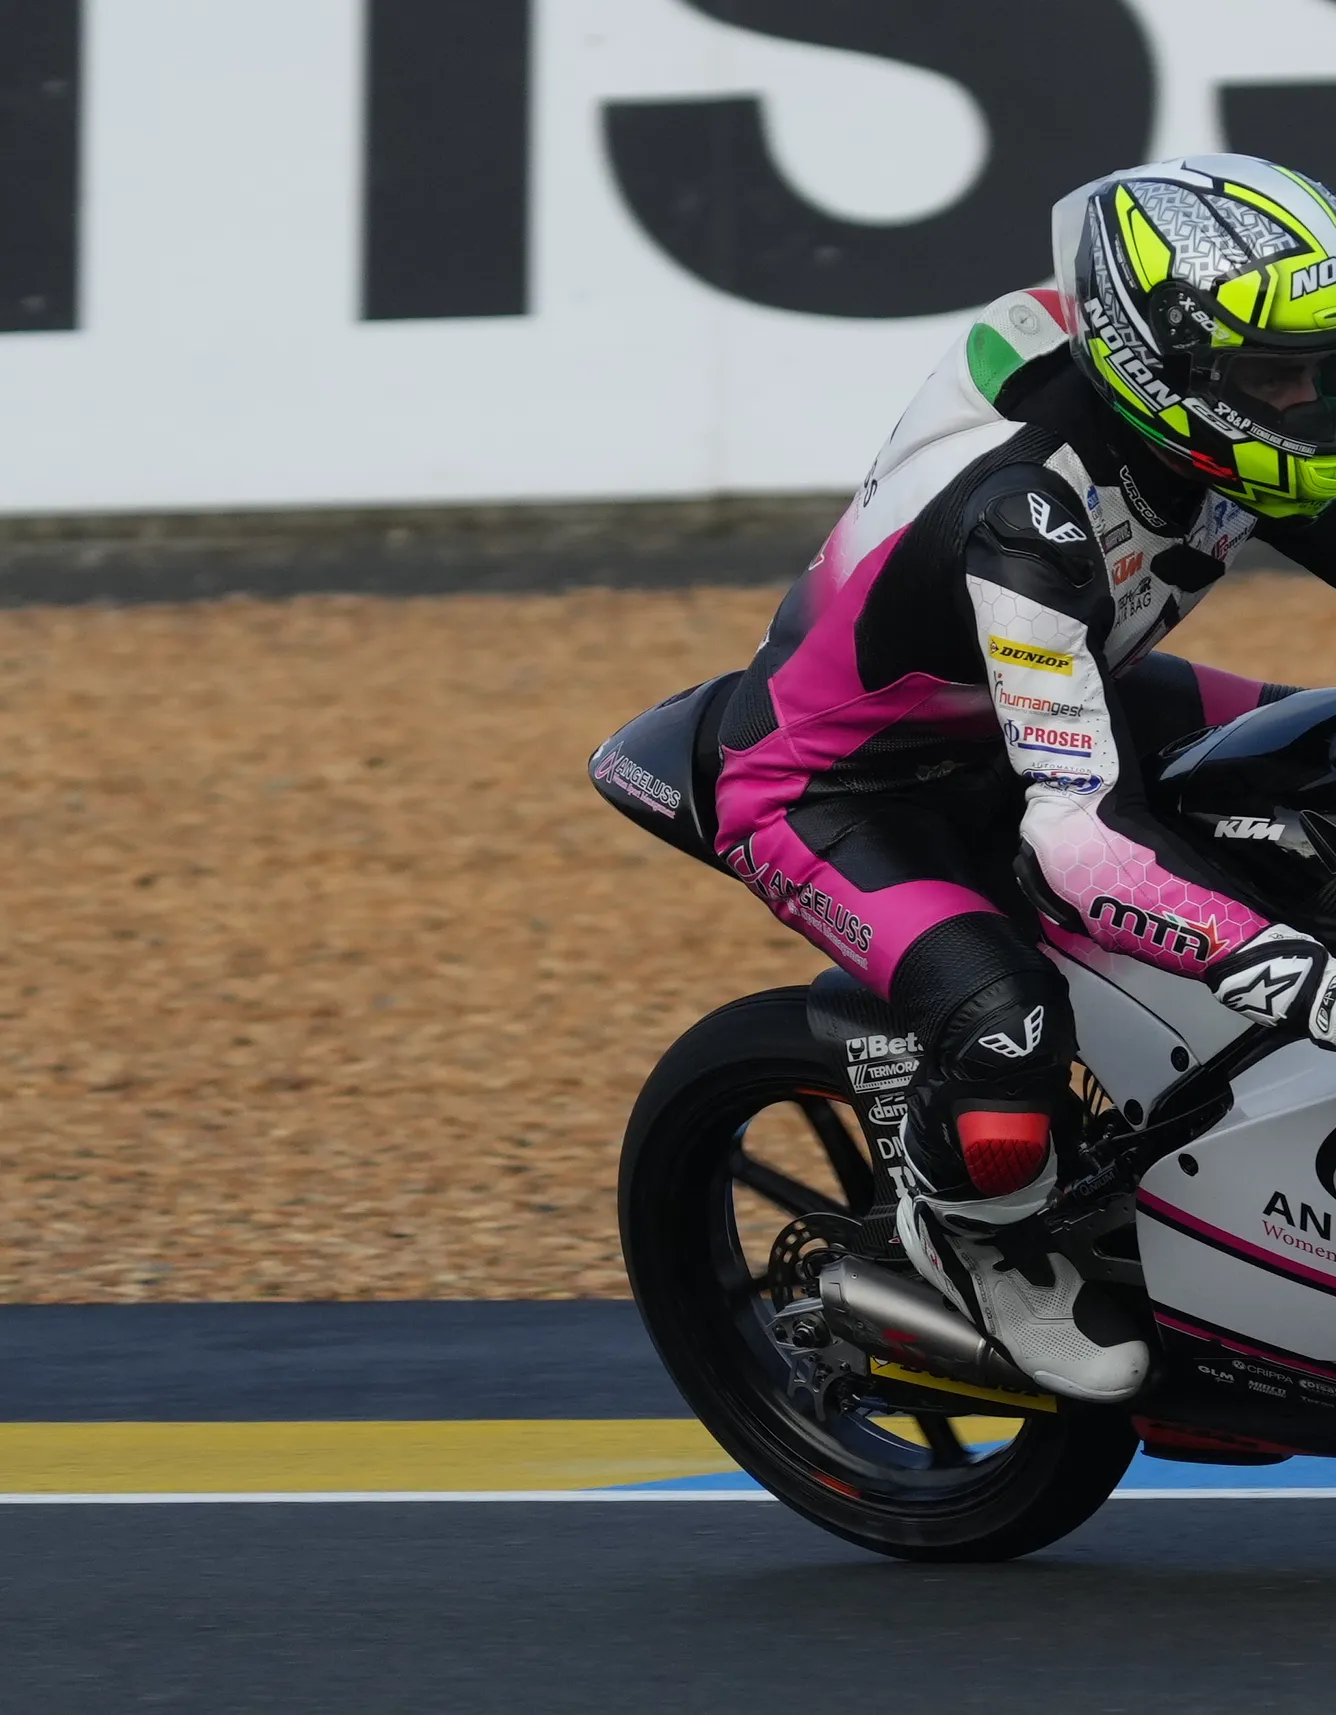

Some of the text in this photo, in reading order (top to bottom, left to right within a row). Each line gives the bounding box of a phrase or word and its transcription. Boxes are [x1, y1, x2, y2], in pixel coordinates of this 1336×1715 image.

[1083, 297, 1182, 412] NOLAN
[1226, 408, 1251, 430] S&P
[1119, 465, 1167, 528] VIRCOS
[1113, 551, 1143, 585] KTM
[999, 645, 1070, 669] DUNLOP
[999, 690, 1084, 718] humangest
[1023, 726, 1093, 750] PROSER
[1031, 762, 1092, 774] AUTOMATION
[615, 755, 681, 809] ANGELUSS
[1213, 815, 1286, 841] KTM
[1246, 1364, 1294, 1385] CRIPPA
